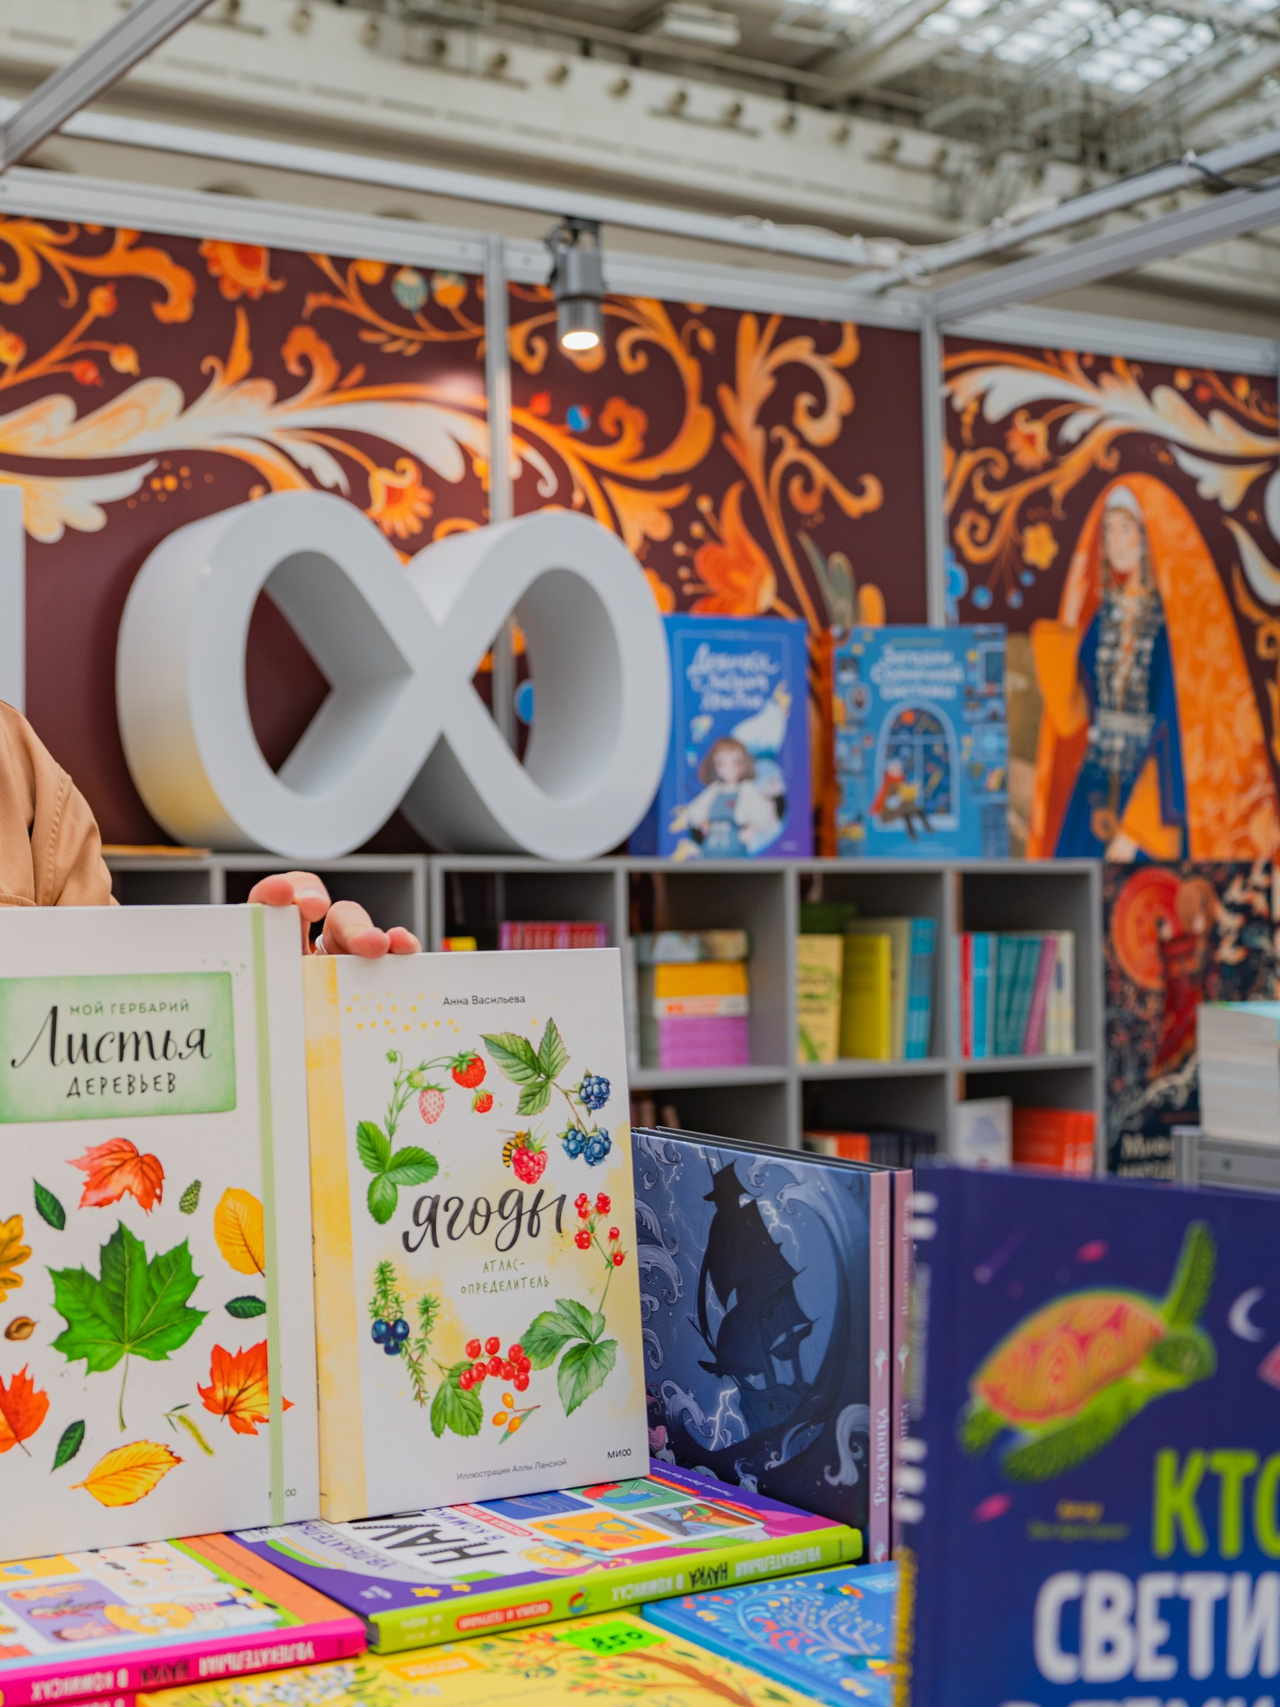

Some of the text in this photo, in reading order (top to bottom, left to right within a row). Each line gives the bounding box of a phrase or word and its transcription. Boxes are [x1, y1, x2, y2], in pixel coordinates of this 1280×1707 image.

[69, 998, 190, 1016] МОЙ ГЕРБАРИЙ
[442, 994, 526, 1007] Анна Васильева
[10, 1005, 213, 1068] Листья
[66, 1071, 177, 1098] ДЕРЕВЬЕВ
[456, 1458, 567, 1482] Иллюстрации Аллы Ланской
[734, 1546, 821, 1576] УВЛЕКАТЕЛЬНАЯ
[675, 1574, 685, 1590] В
[689, 1561, 729, 1590] НАУКА
[611, 1576, 674, 1602] КОМИКСАХ
